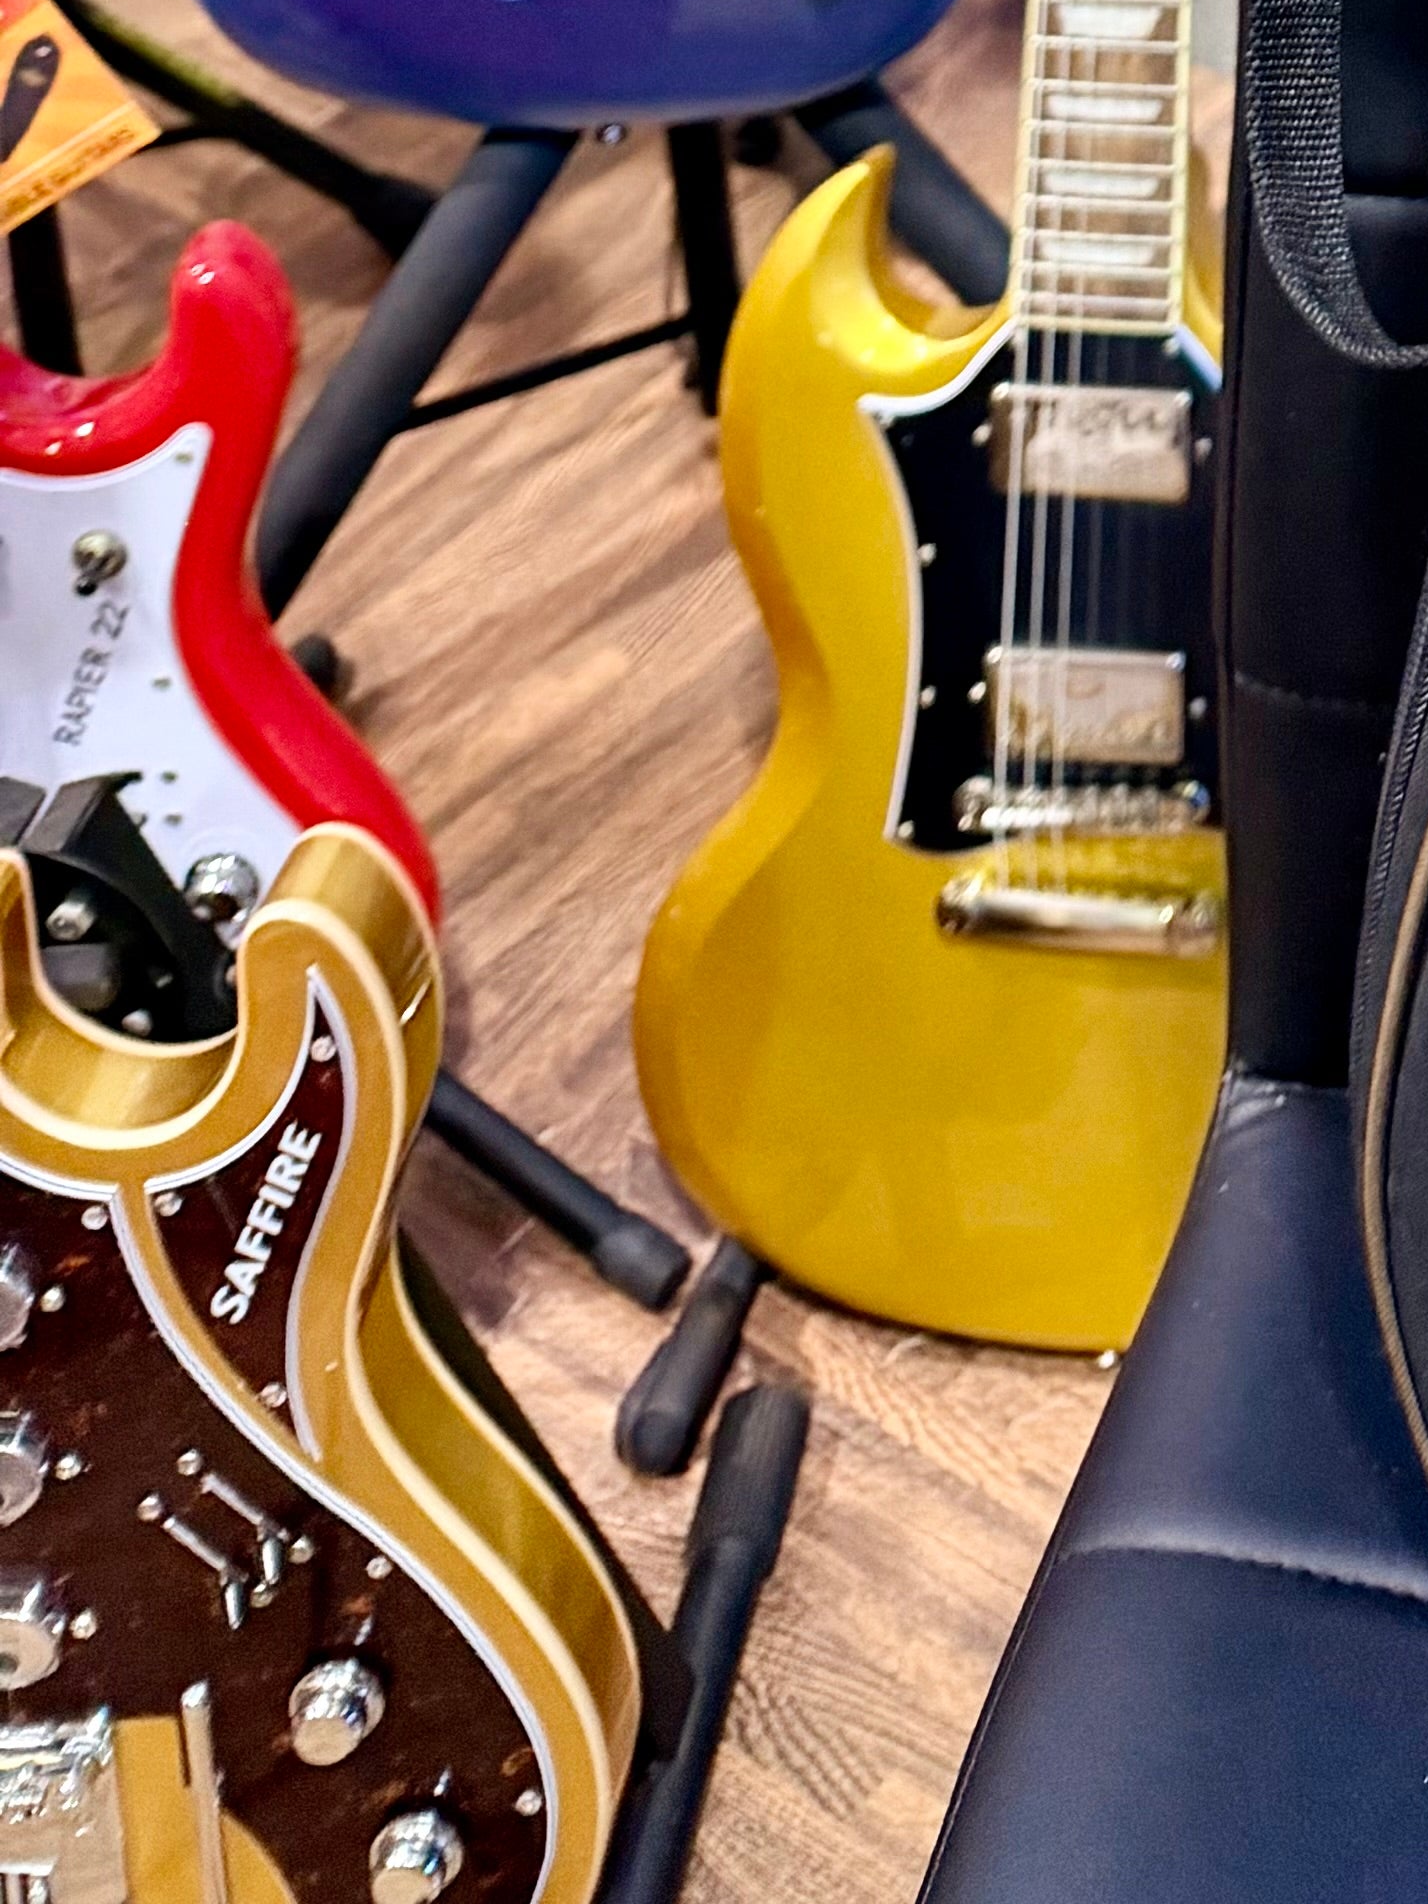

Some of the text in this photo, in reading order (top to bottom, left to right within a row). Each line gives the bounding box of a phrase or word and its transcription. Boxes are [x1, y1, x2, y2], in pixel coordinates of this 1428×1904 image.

[53, 600, 131, 747] RAPIER 22
[209, 1118, 323, 1326] SAFFIRE
